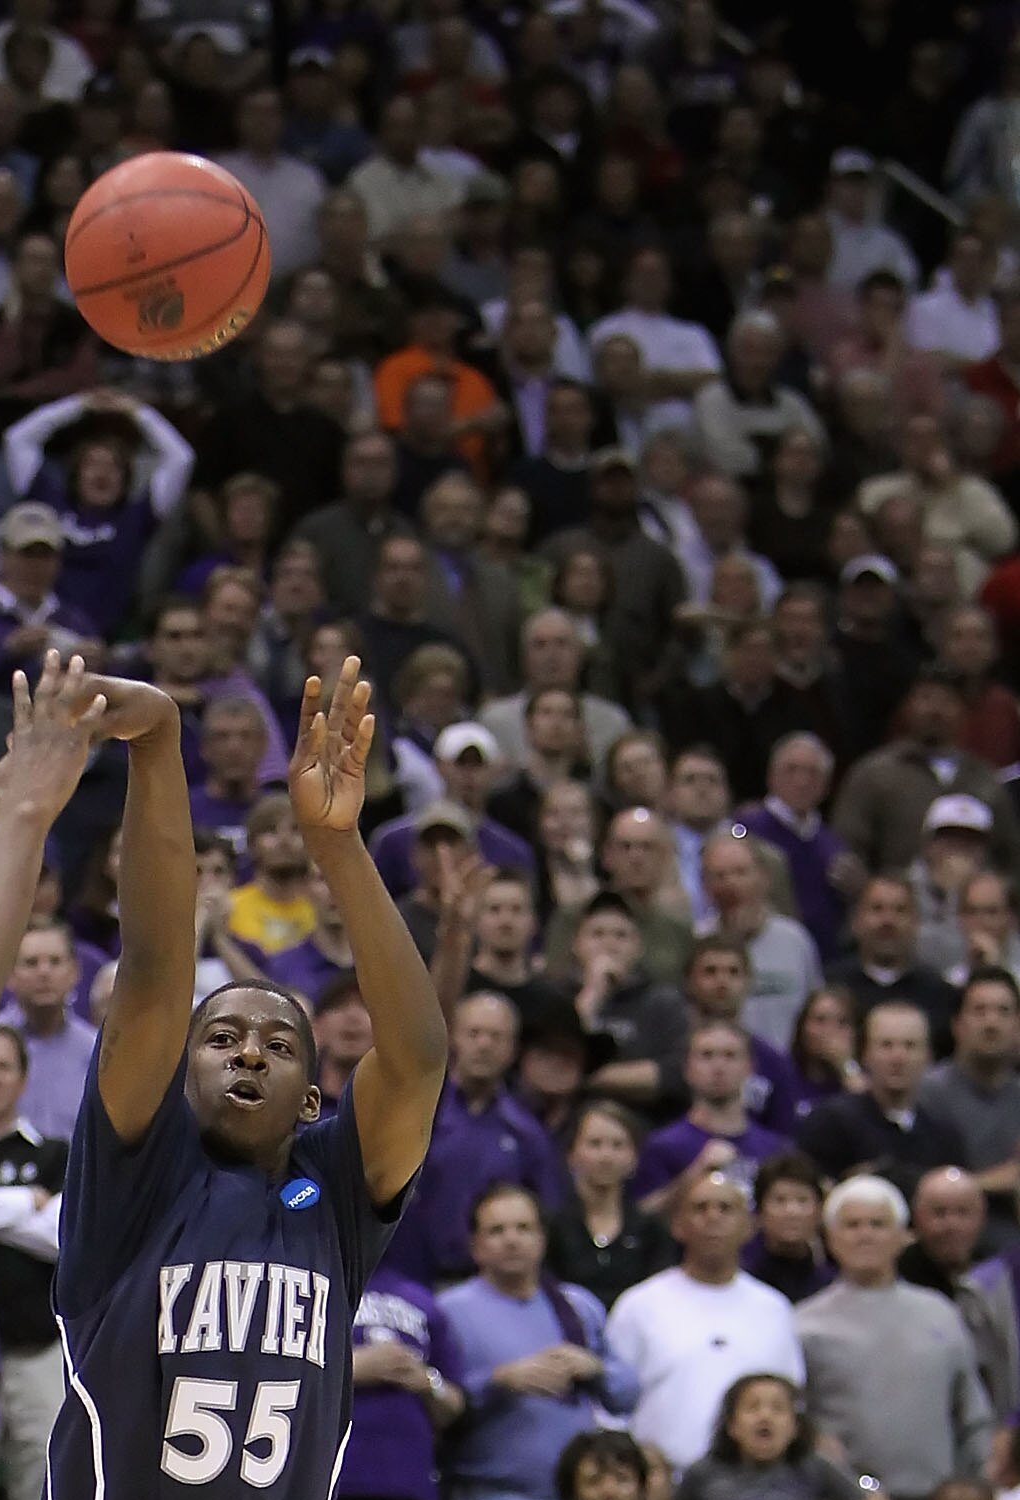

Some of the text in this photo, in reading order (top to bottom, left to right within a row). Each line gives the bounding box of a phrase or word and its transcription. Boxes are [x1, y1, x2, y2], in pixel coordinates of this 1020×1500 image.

[288, 1185, 316, 1208] NCAA
[158, 1261, 330, 1369] XAVIER
[160, 1376, 302, 1489] 55
